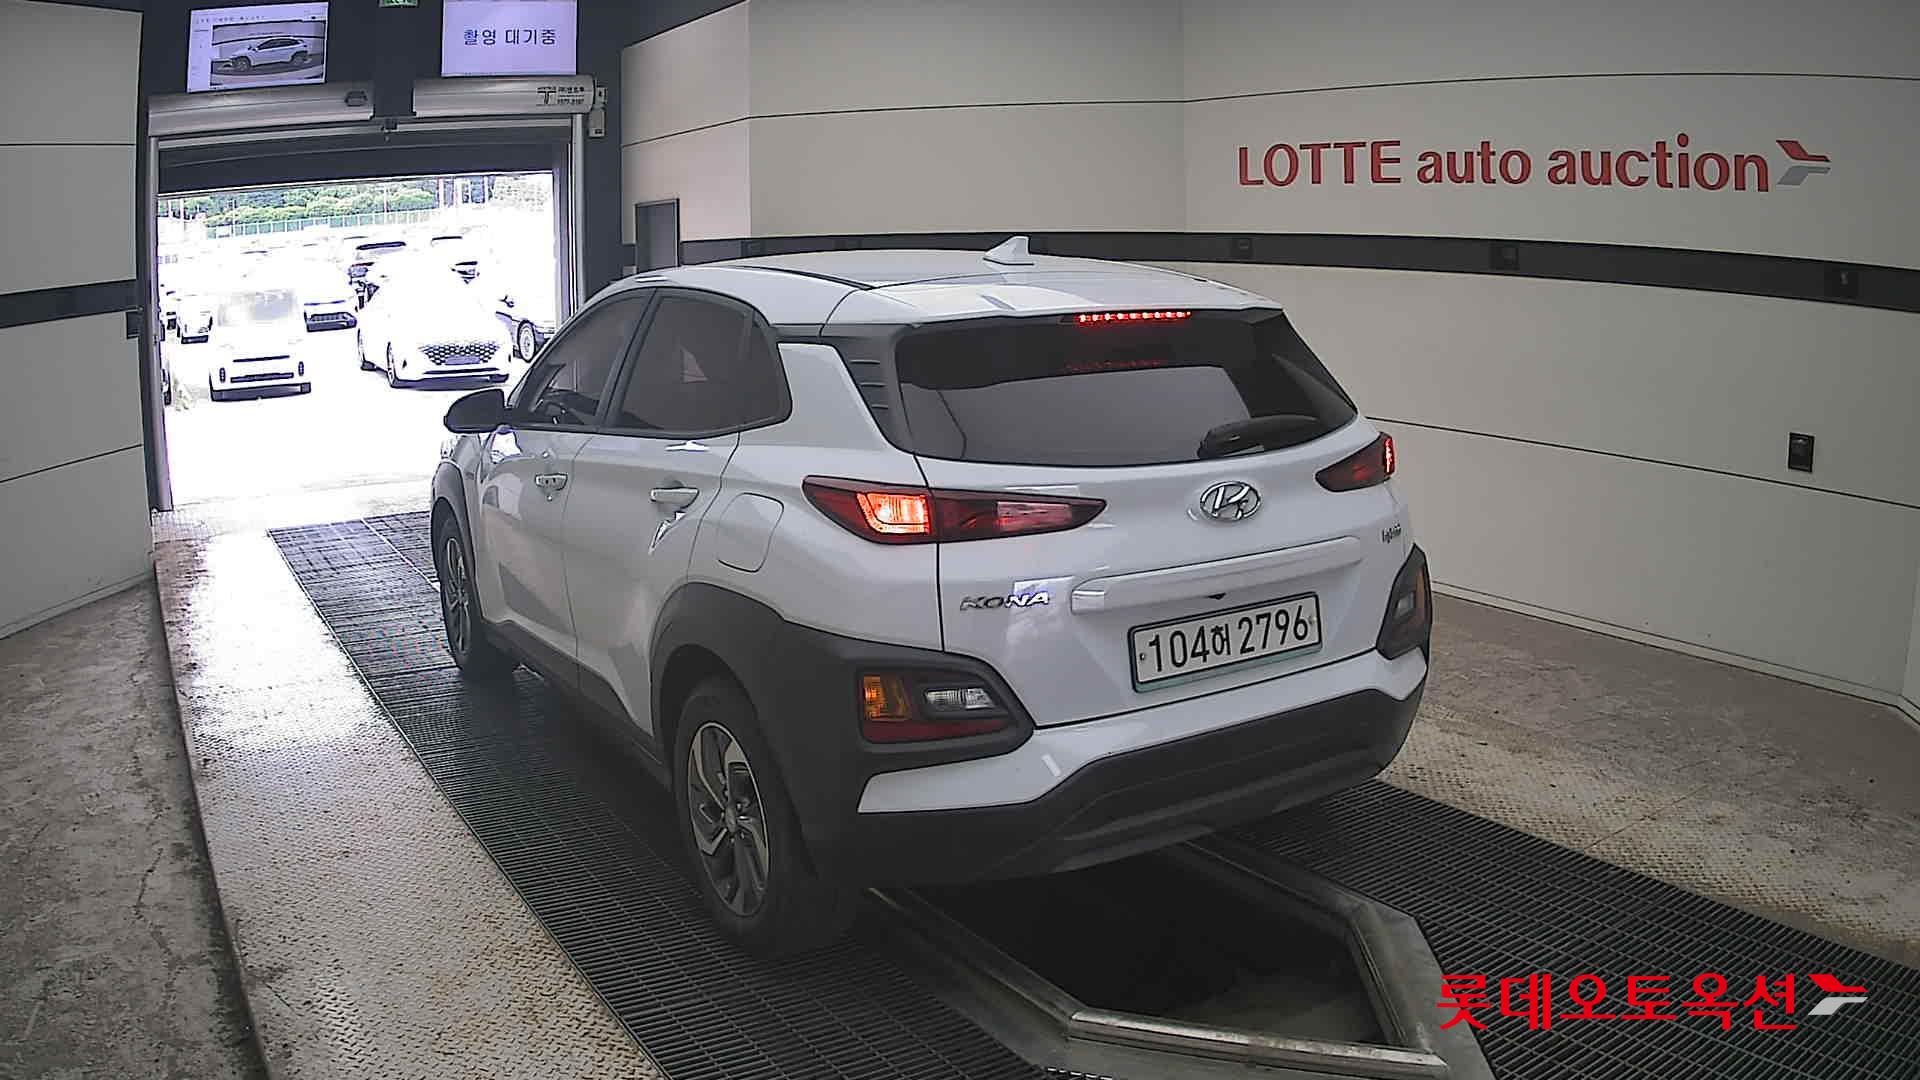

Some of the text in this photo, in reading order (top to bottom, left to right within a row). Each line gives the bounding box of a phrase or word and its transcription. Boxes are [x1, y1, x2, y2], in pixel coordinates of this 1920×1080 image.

[463, 29, 556, 46] 촬영 대기중
[1239, 133, 1770, 192] LOTTE auto auction
[960, 591, 1049, 611] KONA
[1149, 605, 1308, 673] 104허 2796
